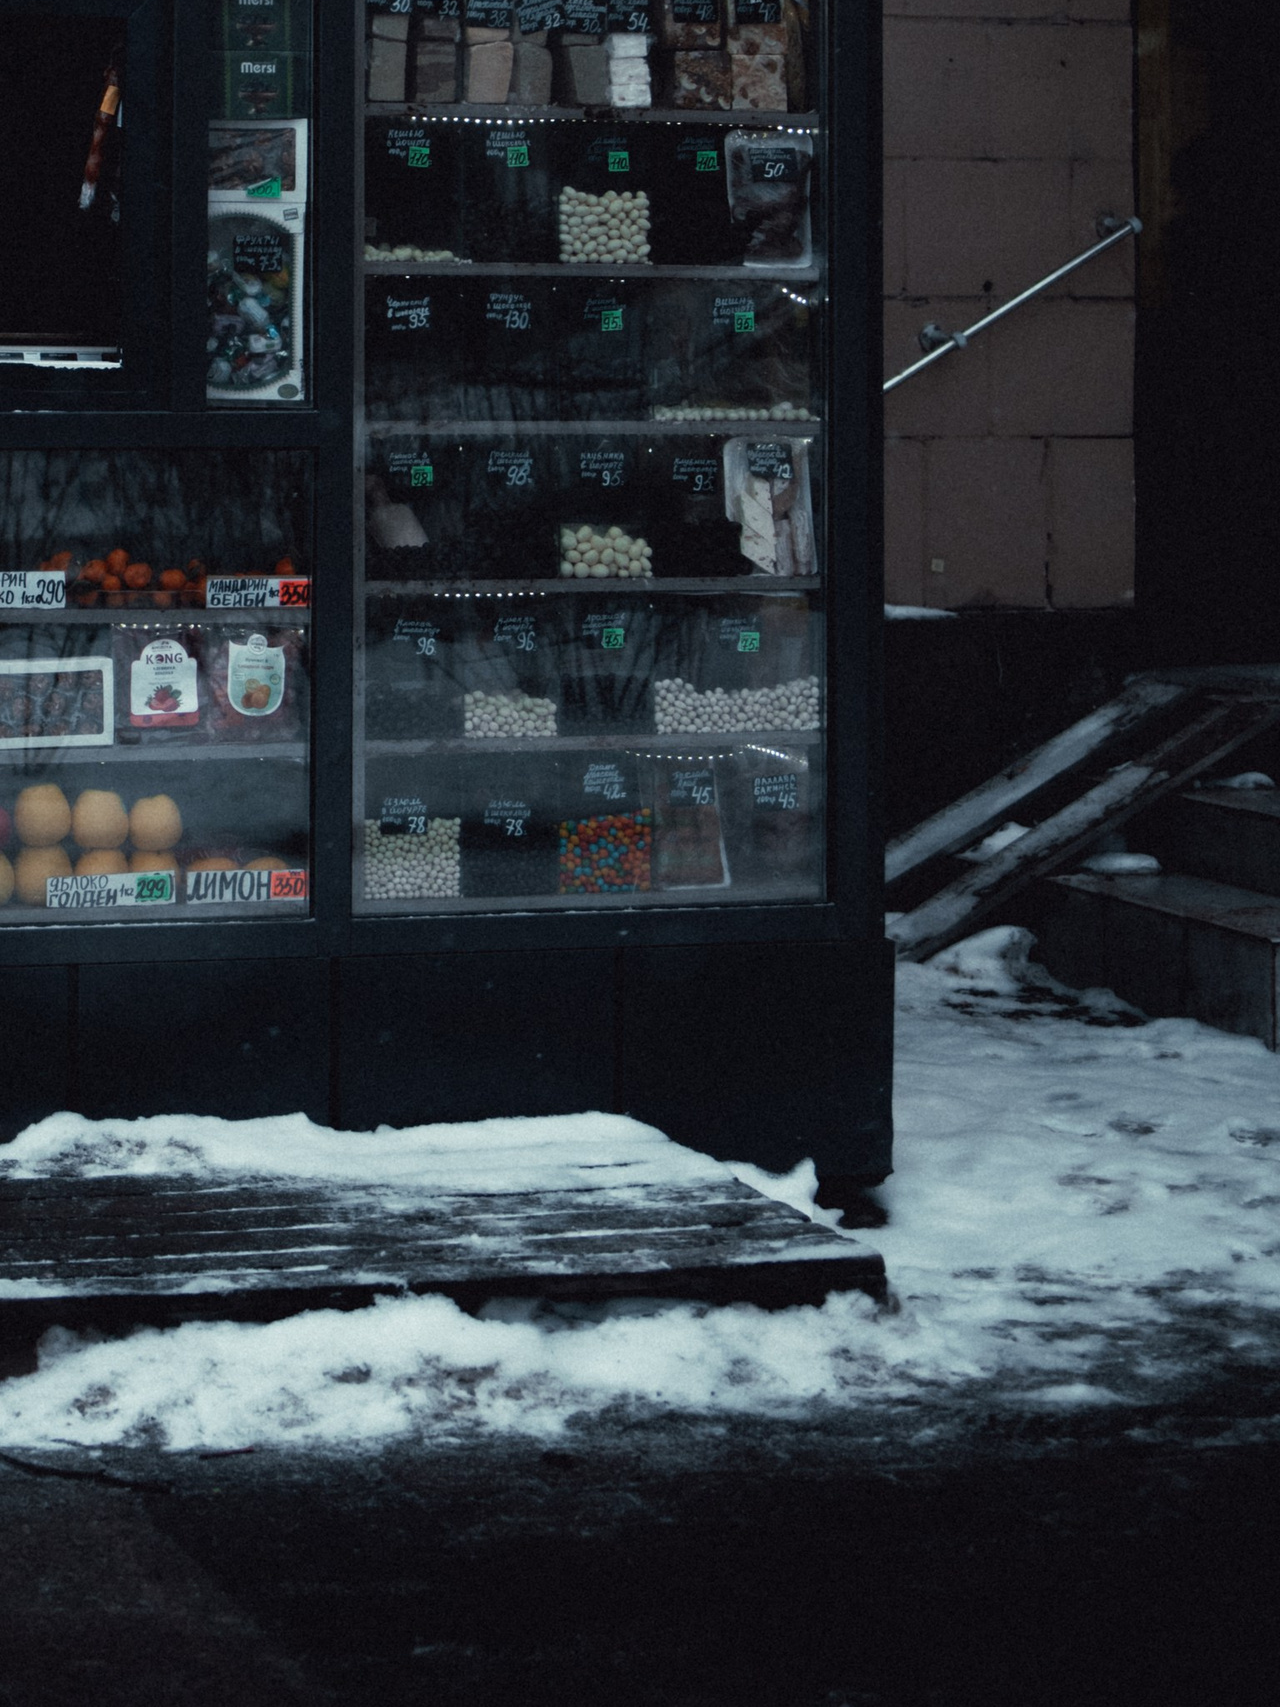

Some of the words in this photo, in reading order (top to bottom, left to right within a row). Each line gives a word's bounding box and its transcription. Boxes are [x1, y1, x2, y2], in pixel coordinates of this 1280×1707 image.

[240, 61, 277, 74] Mersi
[208, 578, 269, 593] МАНДАРИН
[210, 592, 267, 607] БЕЙБИ
[145, 651, 184, 665] KONG
[48, 876, 109, 892] ЯБЛОКО
[186, 871, 272, 902] ЛИМОН
[273, 877, 306, 898] 350
[47, 888, 117, 907] ГОЛДЕН
[136, 878, 169, 900] 299
